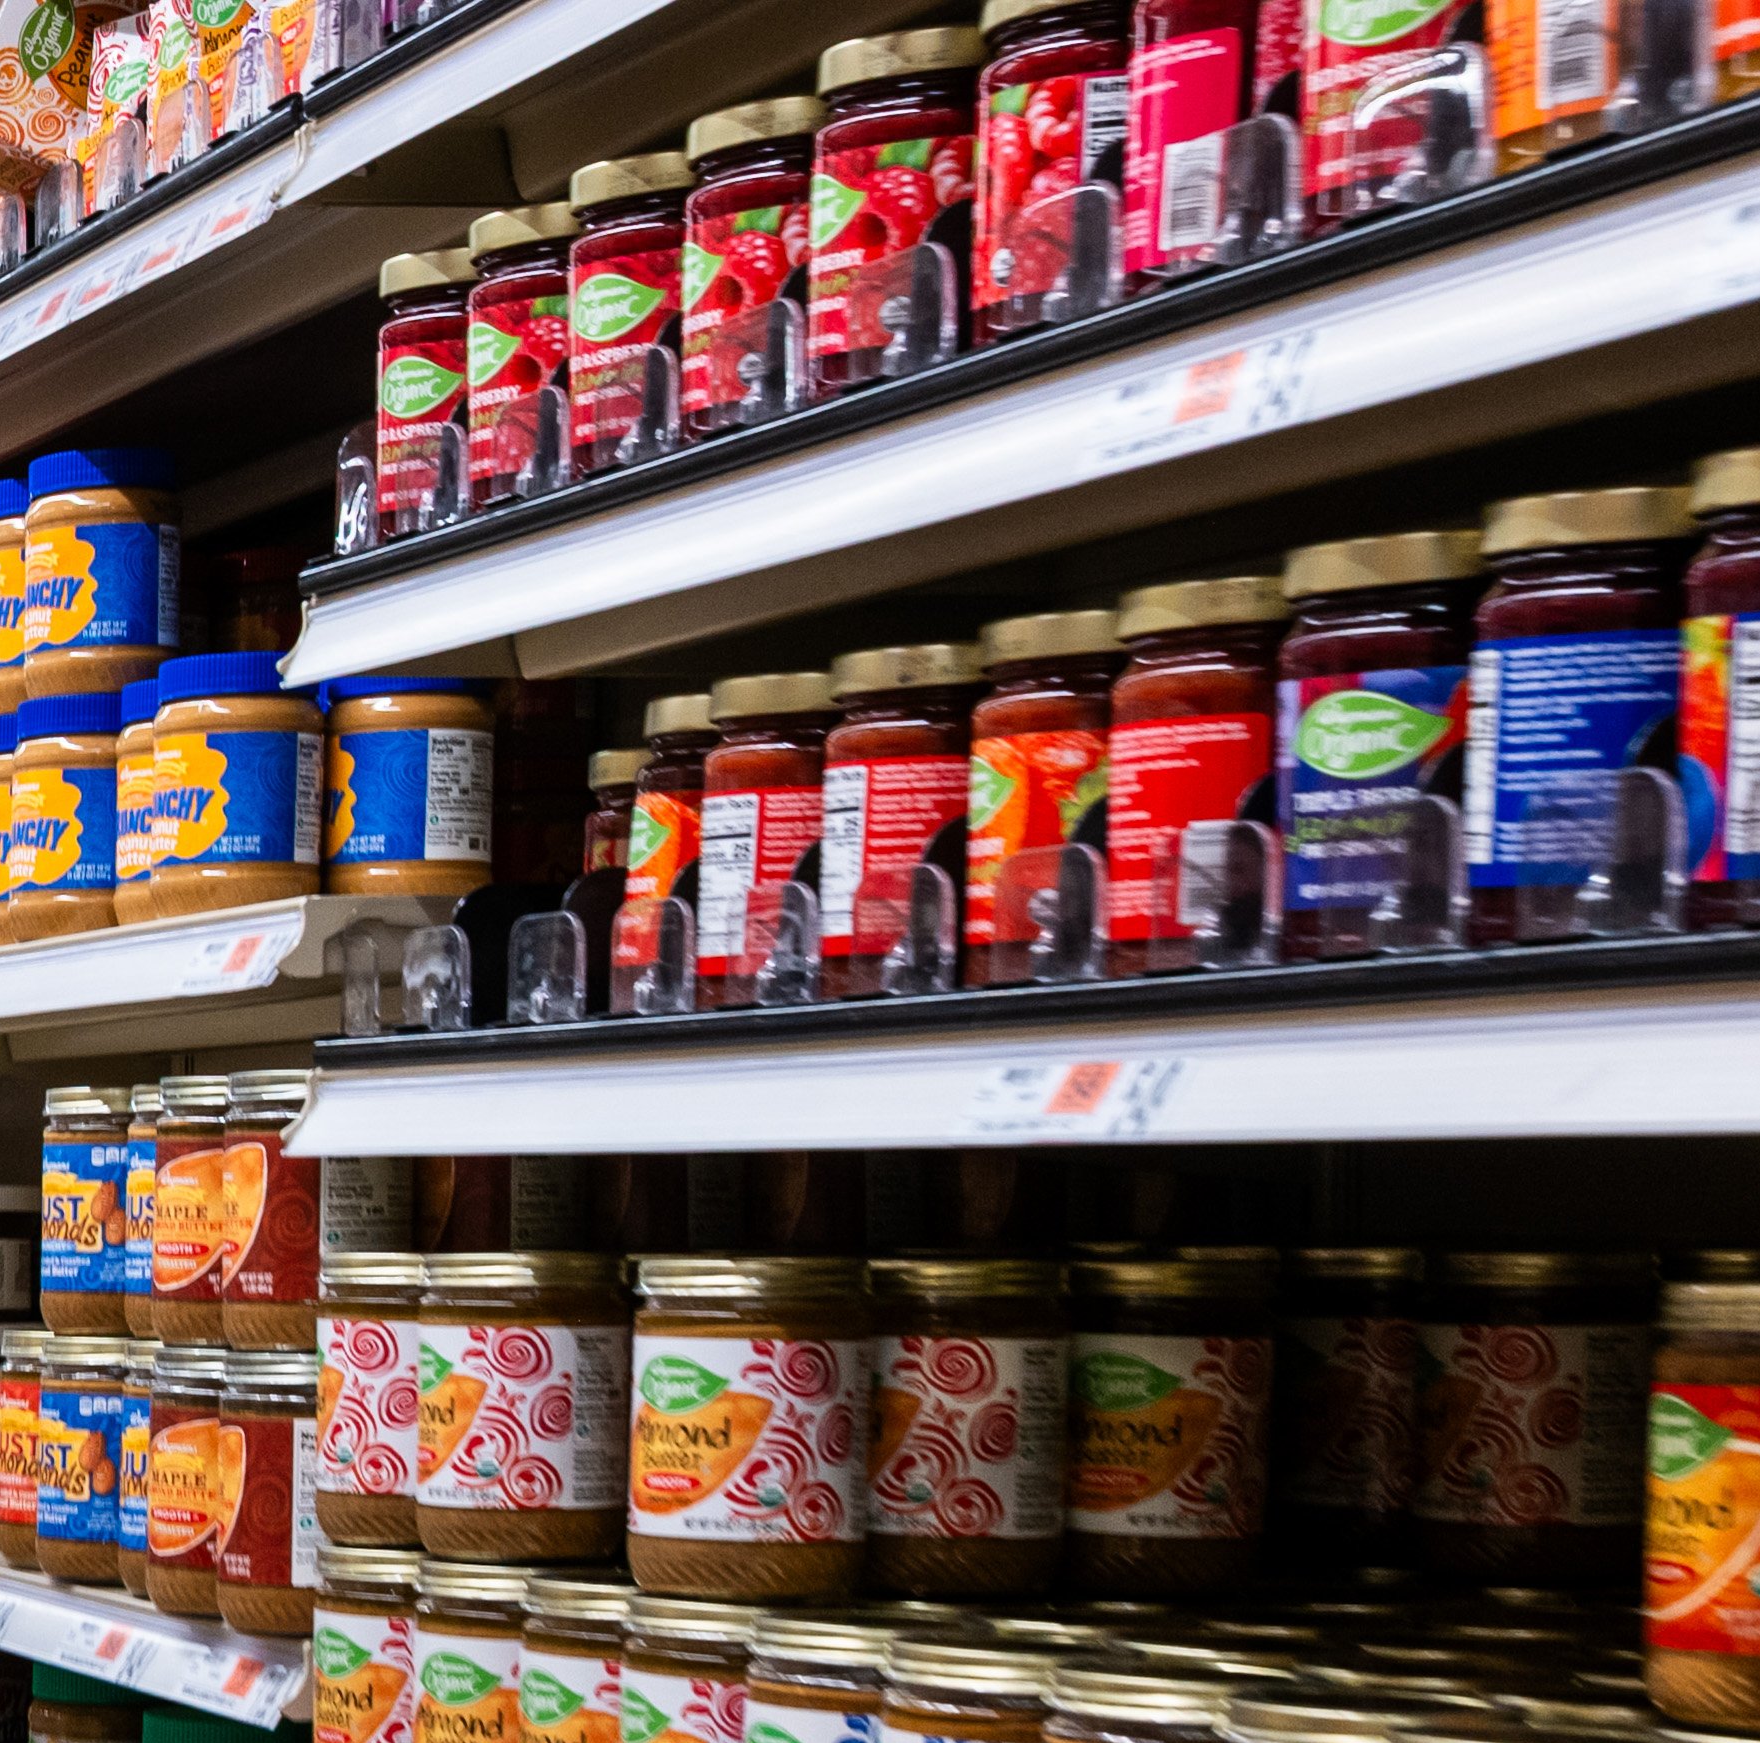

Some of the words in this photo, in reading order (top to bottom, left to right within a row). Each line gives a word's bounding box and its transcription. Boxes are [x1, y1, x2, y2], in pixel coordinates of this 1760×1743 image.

[30, 2, 70, 71] Organic
[25, 575, 85, 611] NCHY
[154, 786, 215, 824] NCHY
[12, 818, 70, 852] NCHY
[42, 1195, 84, 1220] UST
[0, 1431, 38, 1455] UST
[39, 1443, 72, 1469] UST
[316, 1683, 374, 1713] mond
